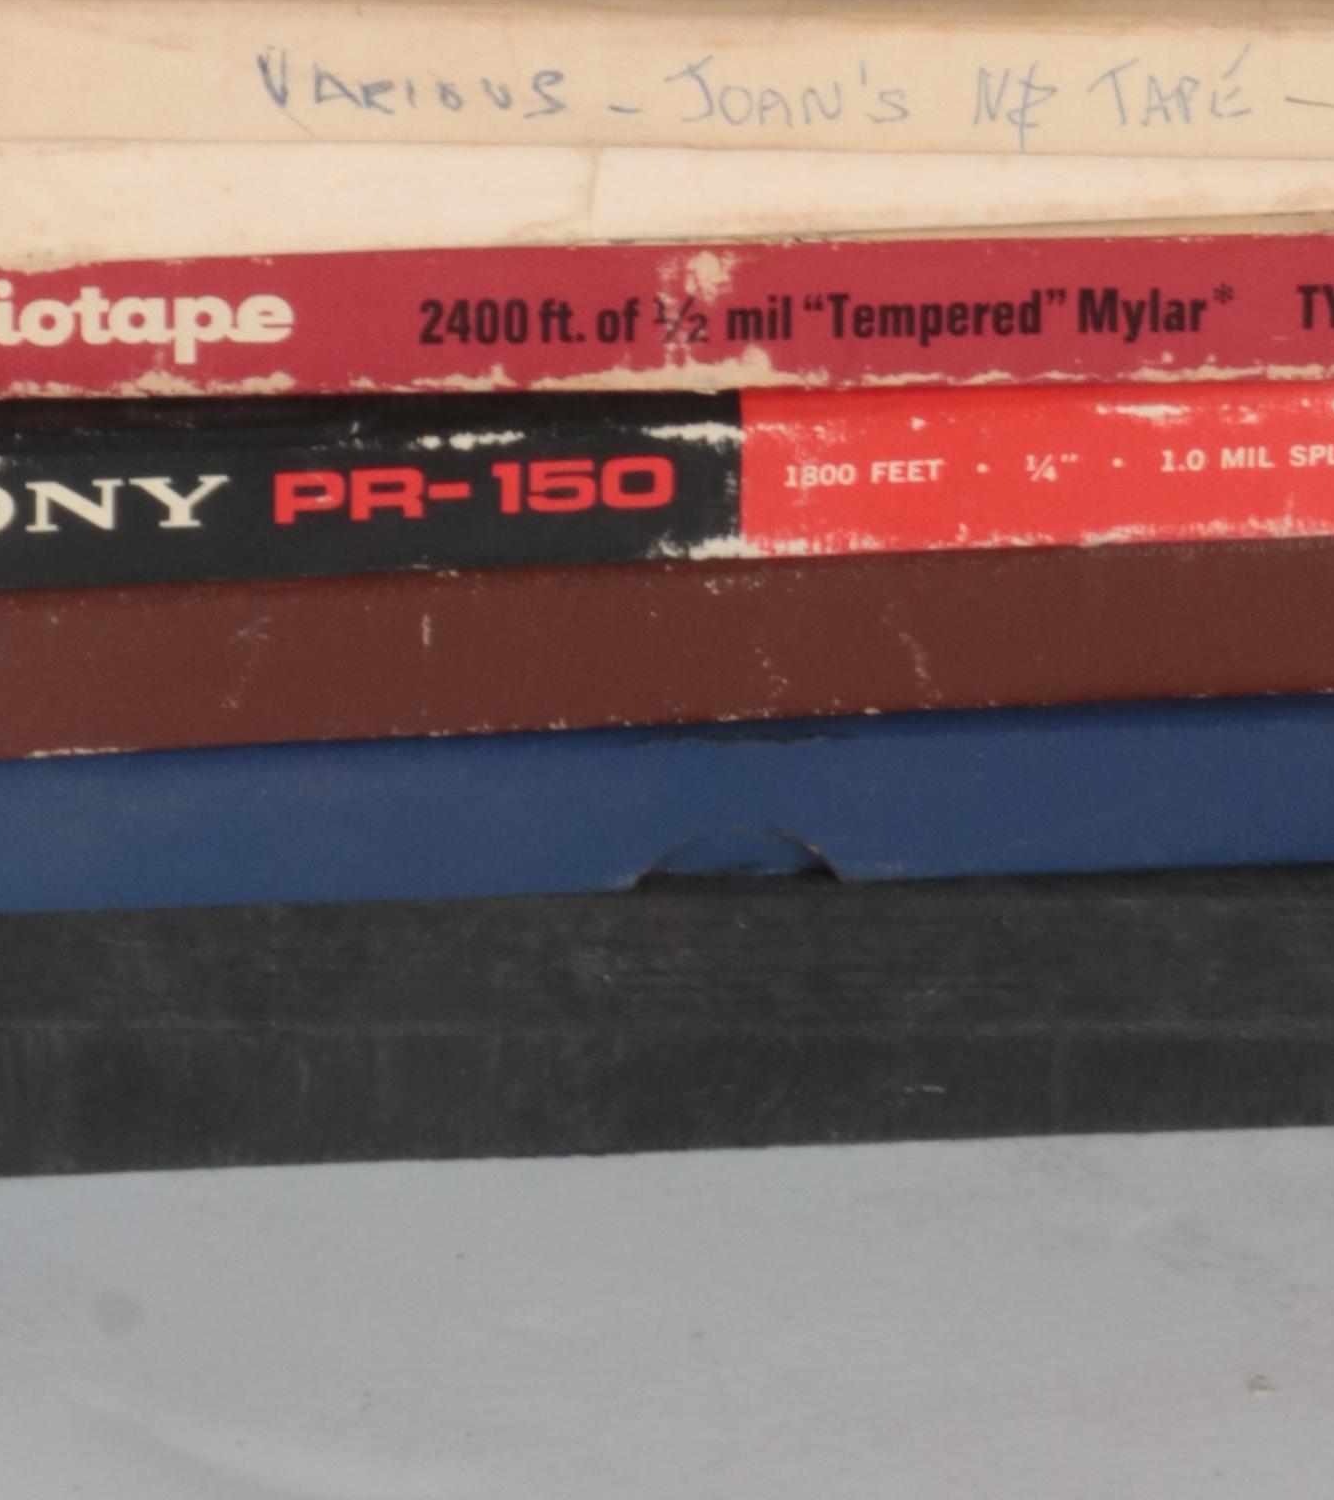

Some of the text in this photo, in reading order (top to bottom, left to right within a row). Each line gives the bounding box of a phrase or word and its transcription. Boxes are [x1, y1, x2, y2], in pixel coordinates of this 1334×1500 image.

[419, 299, 529, 345] 2400
[539, 296, 586, 342] ft.
[597, 296, 641, 342] of
[726, 295, 793, 341] mil
[784, 464, 857, 487] 1800
[870, 459, 945, 483] FEET
[1161, 449, 1204, 472] 1.0
[1220, 445, 1275, 469] MIL
[274, 457, 675, 526] PR-150
